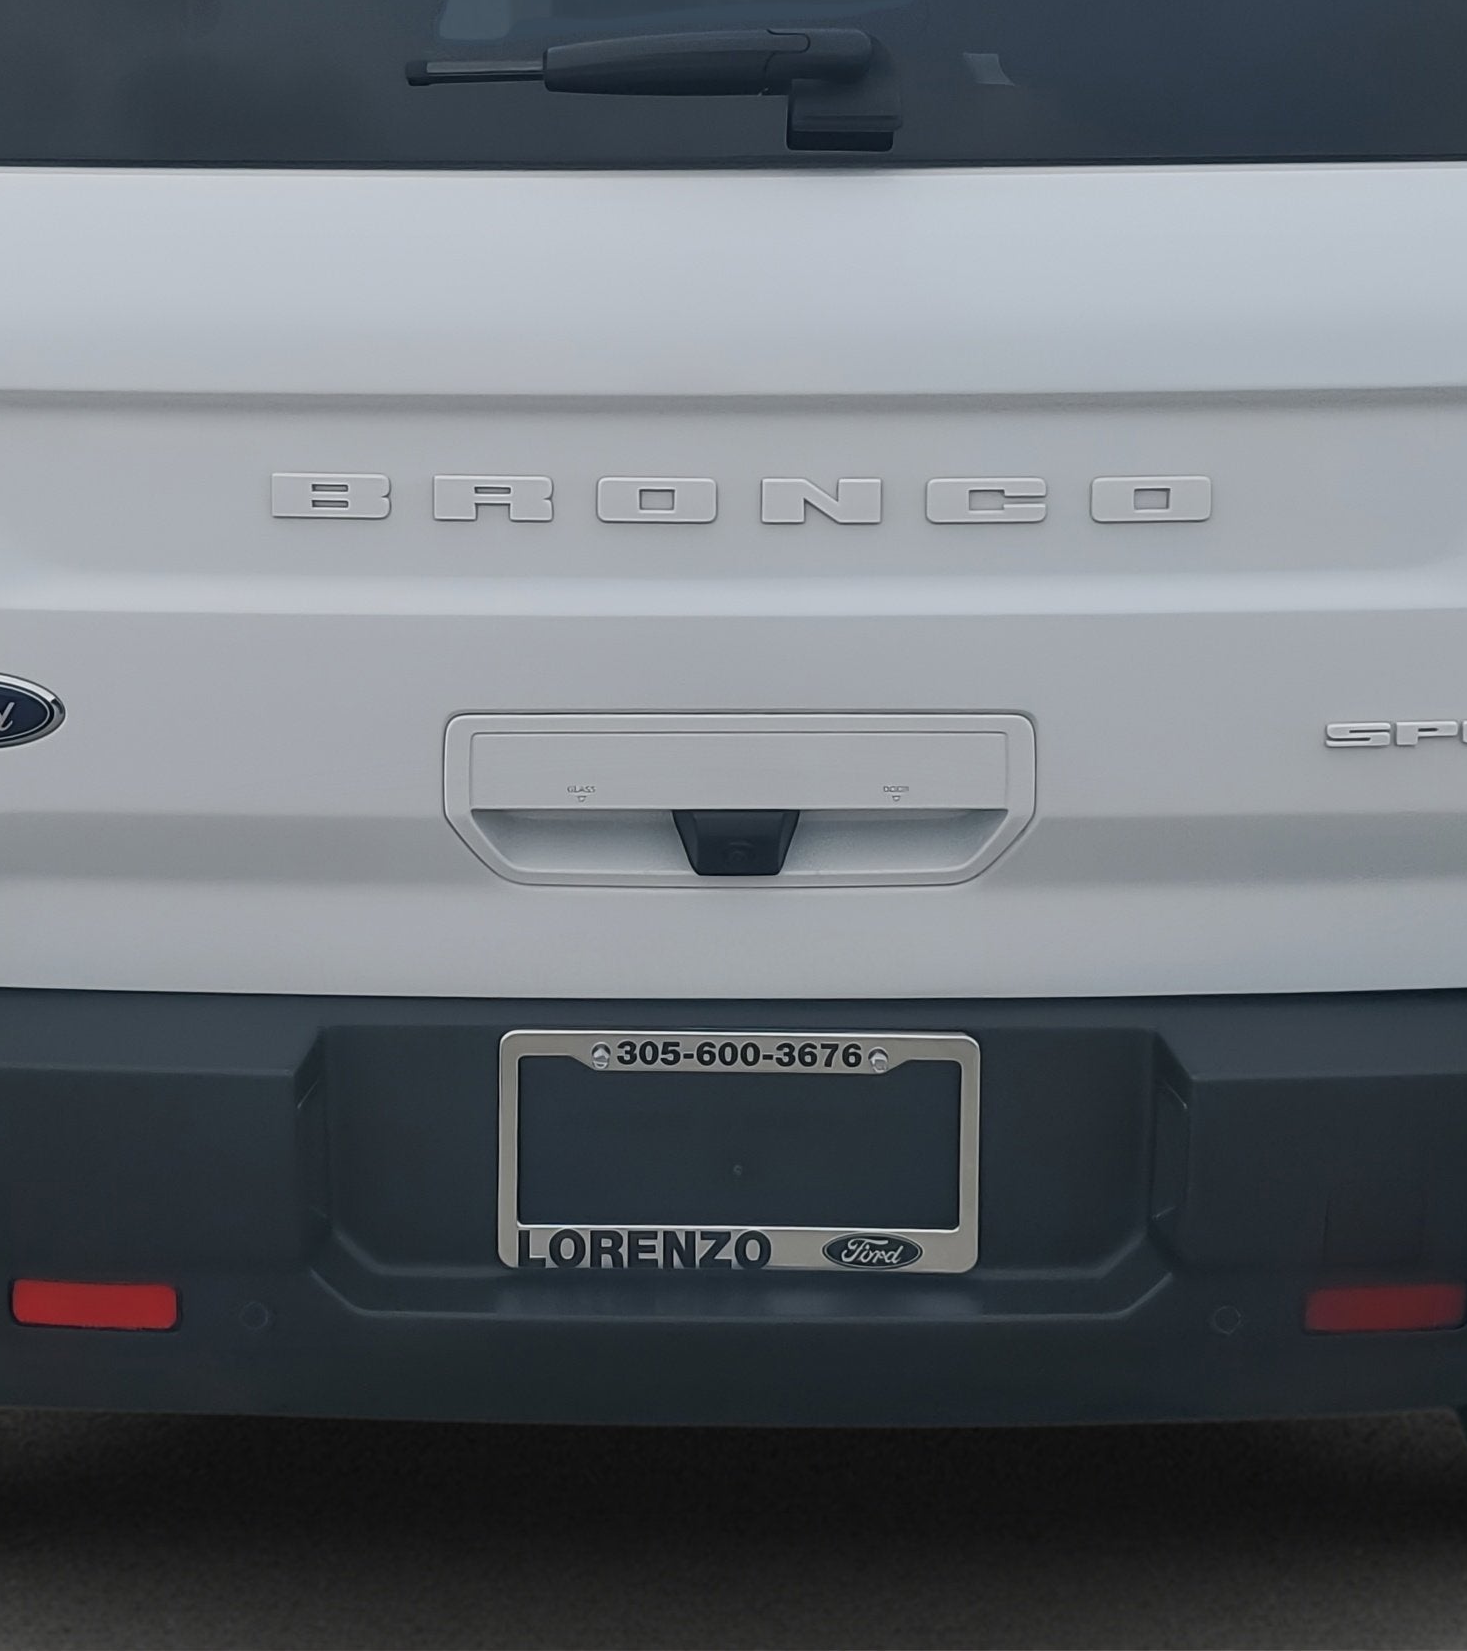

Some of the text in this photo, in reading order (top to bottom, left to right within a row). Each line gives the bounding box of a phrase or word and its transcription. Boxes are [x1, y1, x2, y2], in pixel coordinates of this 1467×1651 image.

[271, 471, 1213, 525] BRONCO
[616, 1041, 862, 1068] 305-600-3676
[517, 1228, 903, 1269] LORENZO Ford
